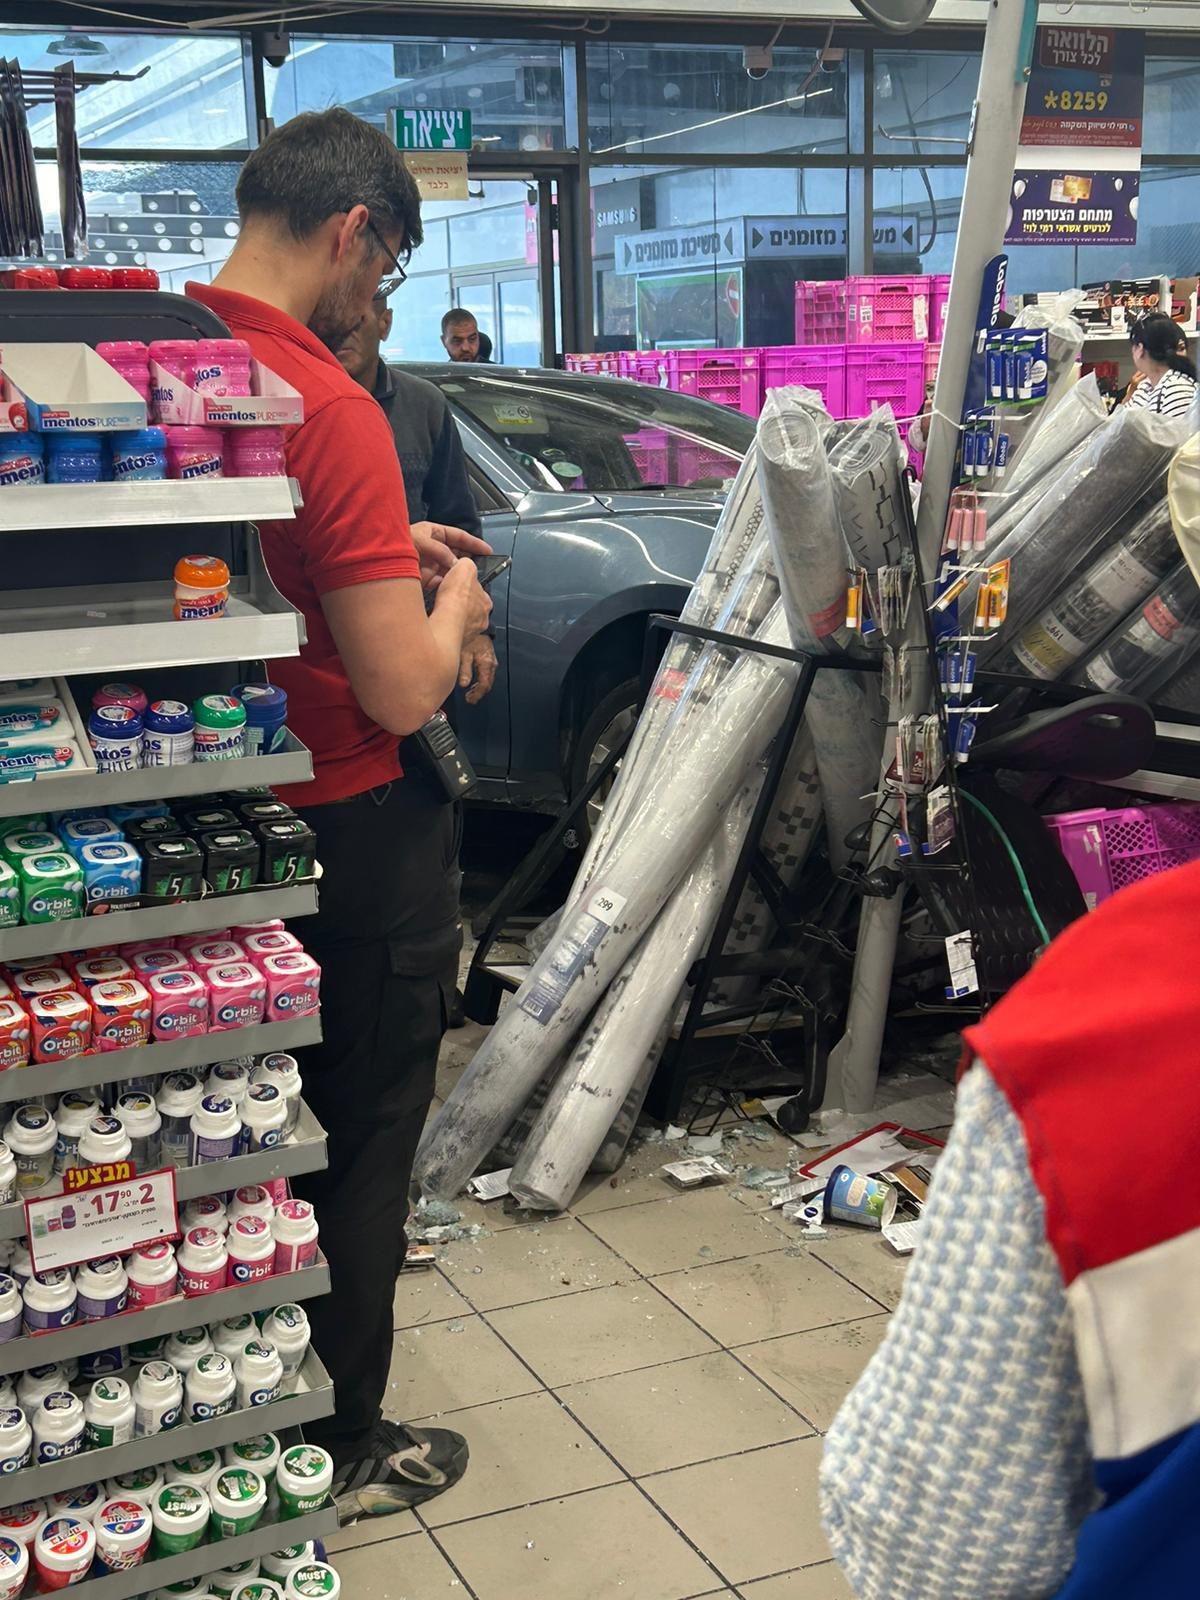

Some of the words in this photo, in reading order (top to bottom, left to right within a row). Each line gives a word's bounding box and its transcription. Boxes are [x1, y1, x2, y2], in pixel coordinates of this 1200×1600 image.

[1047, 28, 1109, 53] הלוואה
[1052, 49, 1078, 65] צורך
[1080, 51, 1102, 66] לכל
[403, 110, 463, 148] יציאה
[1022, 208, 1075, 222] הצטרפות
[1078, 209, 1113, 222] מתחם
[1023, 223, 1037, 234] לוי!
[1040, 223, 1054, 233] רמי
[1055, 223, 1081, 233] אשראי
[1082, 223, 1111, 233] לכרטיס
[681, 232, 721, 258] משיכת
[769, 228, 836, 247] מזומנים
[634, 238, 679, 263] מזומנים
[989, 260, 1008, 327] Labello
[43, 416, 98, 428] mentos
[207, 410, 257, 422] mentos
[284, 857, 297, 881] 5
[171, 877, 183, 896] 5
[230, 868, 242, 890] 5
[91, 885, 130, 898] Orbit
[32, 897, 73, 912] Orbit
[598, 897, 613, 912] 299
[277, 992, 312, 1007] Orbit
[221, 1004, 258, 1019] Orbit
[159, 1013, 198, 1028] Orbit
[105, 1025, 143, 1038] Orbit
[43, 1037, 80, 1051] Orbit
[0, 1047, 21, 1060] rbit
[68, 1162, 130, 1189] מבצע!
[138, 1183, 155, 1205] 2
[235, 1262, 272, 1279] Orbit
[297, 1570, 328, 1582] MUST
